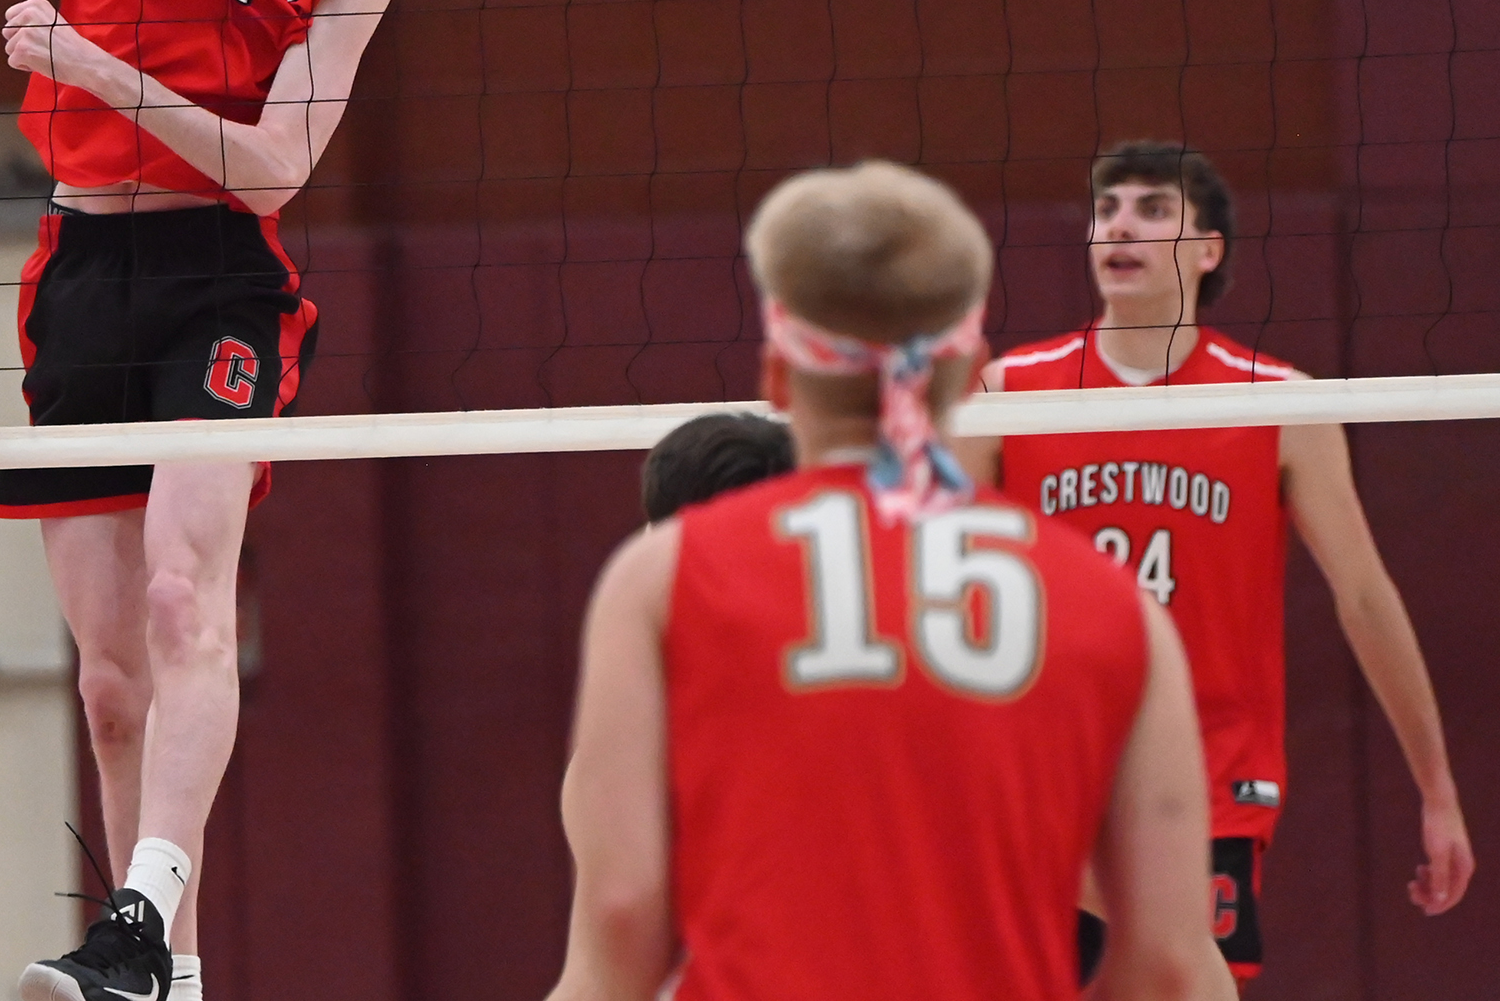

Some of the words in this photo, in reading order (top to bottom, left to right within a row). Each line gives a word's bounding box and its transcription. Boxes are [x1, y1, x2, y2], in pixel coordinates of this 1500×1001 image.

[203, 335, 260, 410] C
[1039, 461, 1231, 524] CRESTWOOD
[772, 488, 1048, 704] 15
